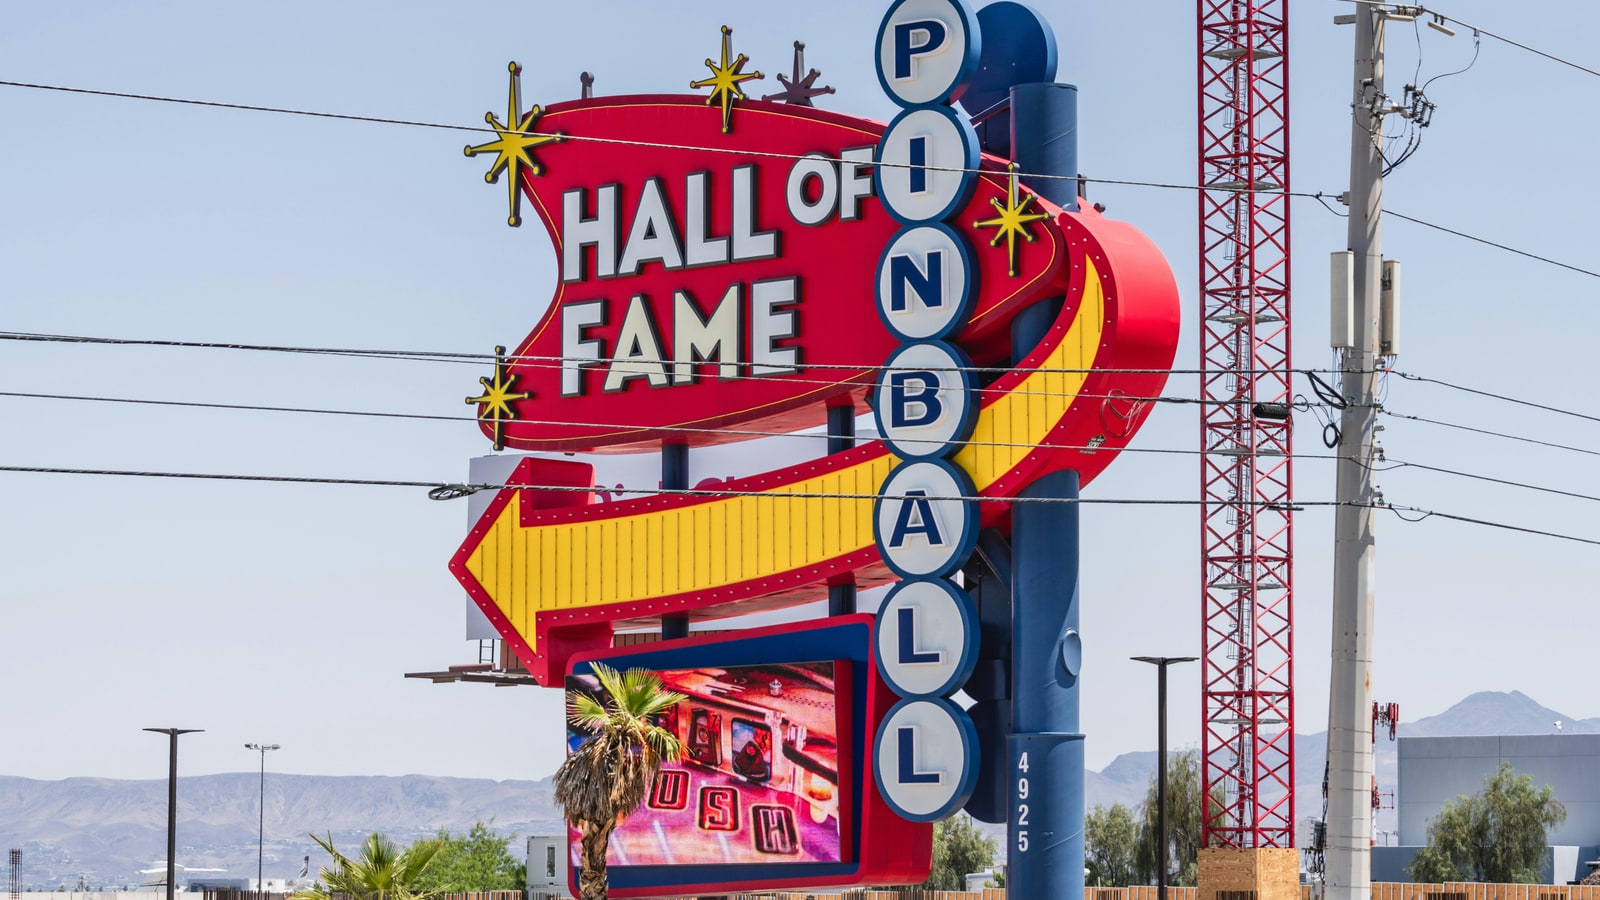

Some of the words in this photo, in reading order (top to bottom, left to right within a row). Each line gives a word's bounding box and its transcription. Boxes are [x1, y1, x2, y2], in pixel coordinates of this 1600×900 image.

[562, 164, 779, 283] HALL
[785, 145, 876, 226] OF
[561, 276, 801, 396] FAME
[888, 18, 950, 787] PINBALL
[1018, 752, 1029, 852] 4925
